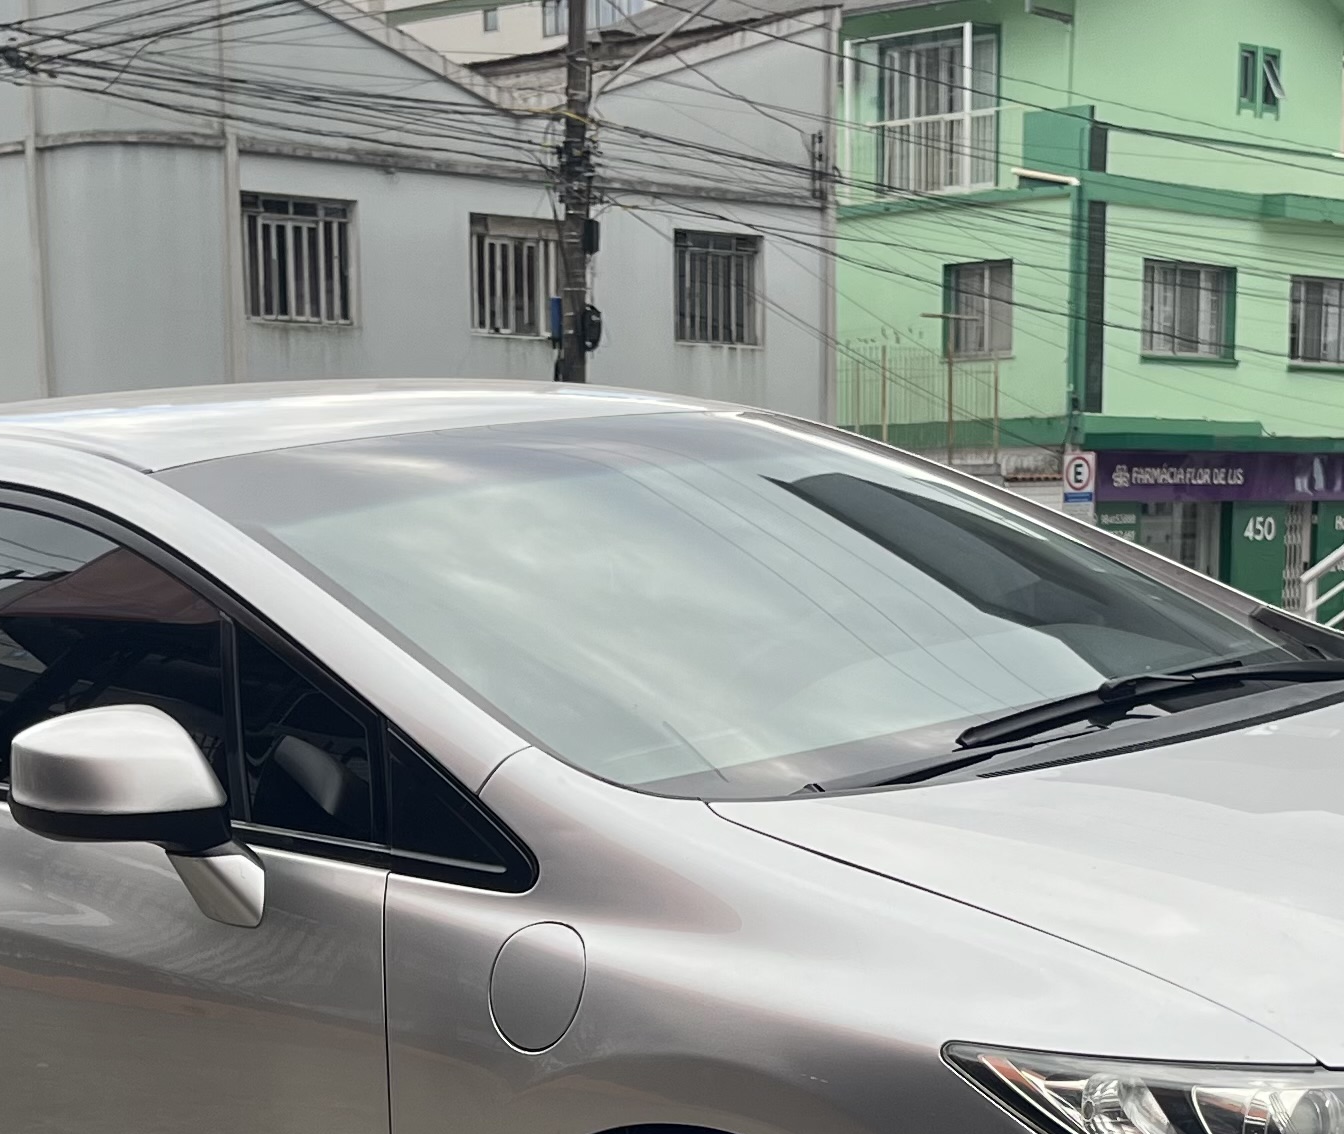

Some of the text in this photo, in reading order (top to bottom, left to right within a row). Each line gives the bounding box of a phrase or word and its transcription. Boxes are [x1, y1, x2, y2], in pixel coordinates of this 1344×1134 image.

[1074, 464, 1084, 484] E
[1186, 467, 1211, 485] FLOR
[1213, 468, 1226, 485] DE
[1243, 515, 1276, 542] 450
